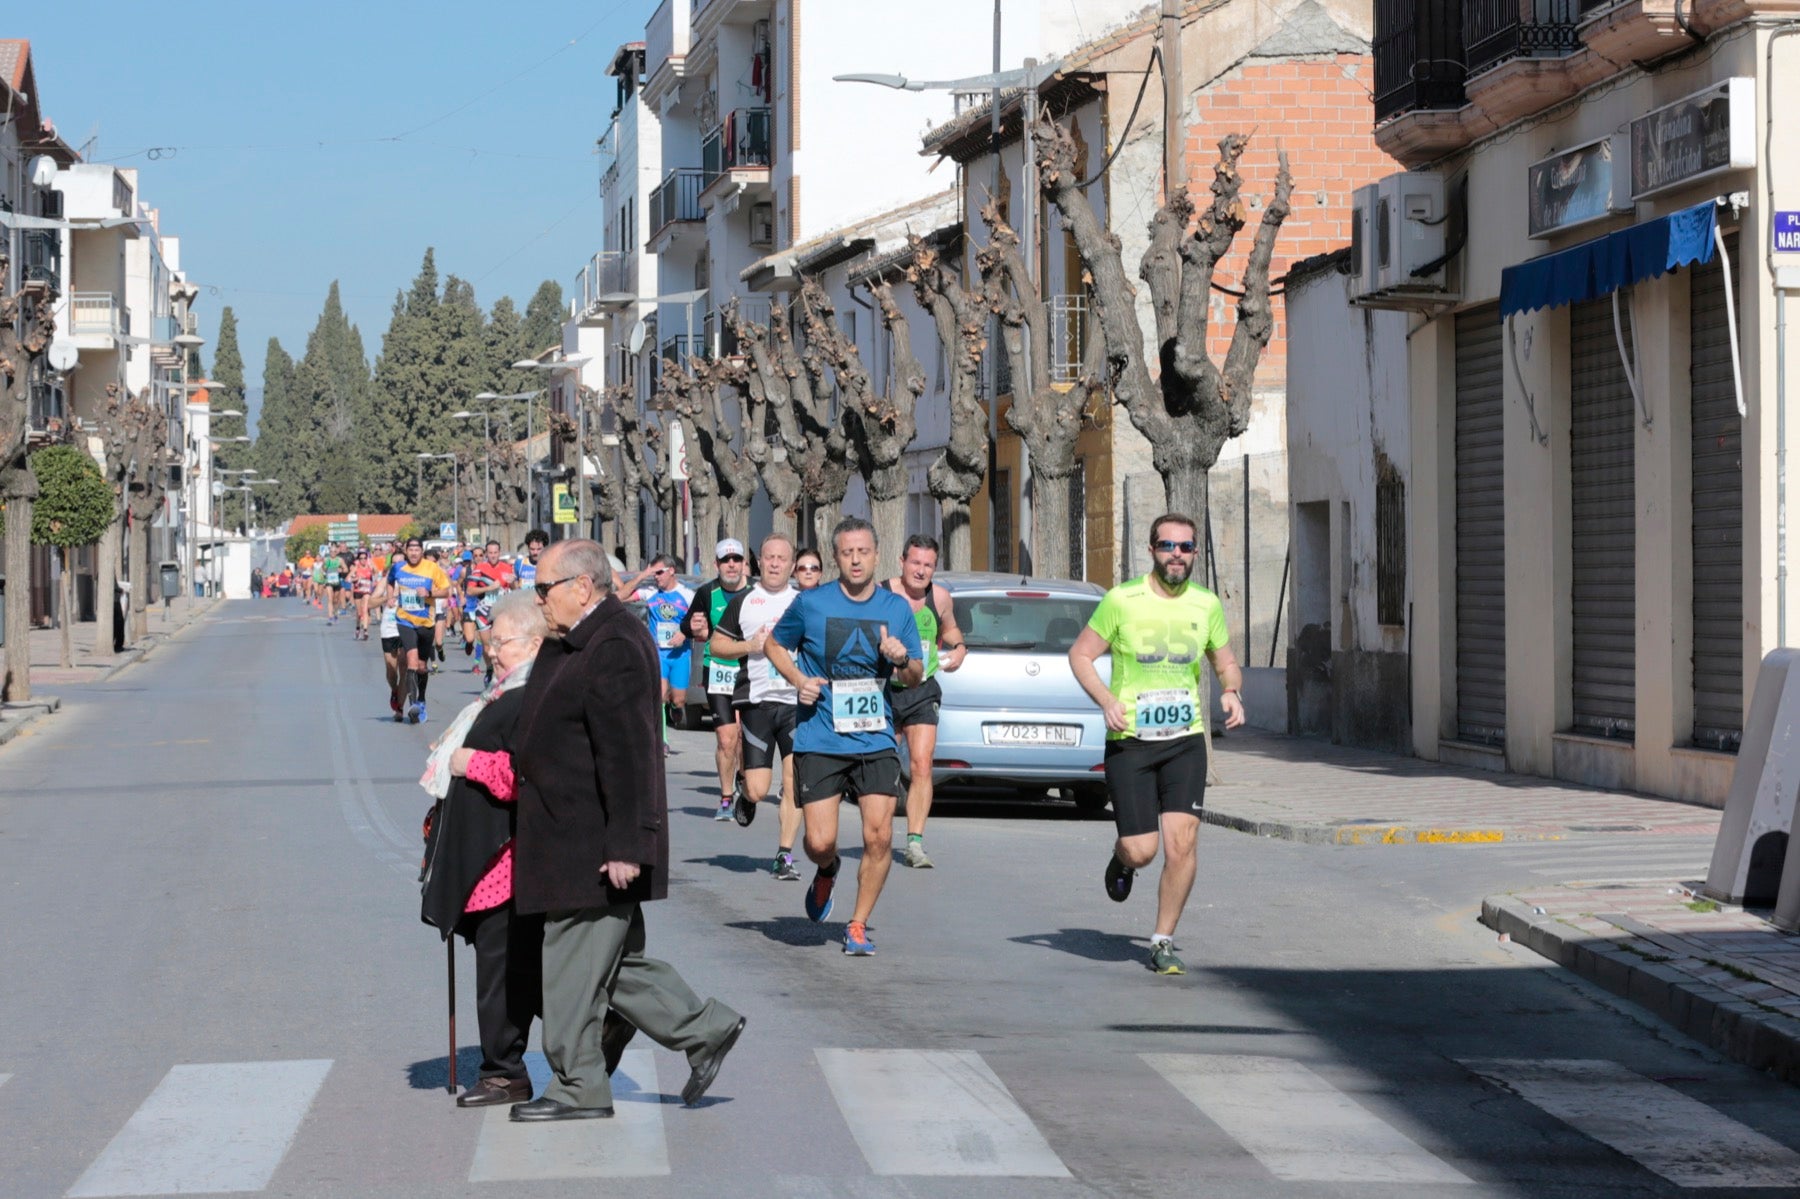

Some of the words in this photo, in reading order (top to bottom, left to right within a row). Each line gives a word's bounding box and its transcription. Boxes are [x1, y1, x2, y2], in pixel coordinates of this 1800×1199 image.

[1136, 620, 1198, 664] 35
[844, 695, 878, 715] 126
[1140, 704, 1192, 725] 1093
[1002, 725, 1039, 739] 7023
[1045, 726, 1072, 740] FNL
